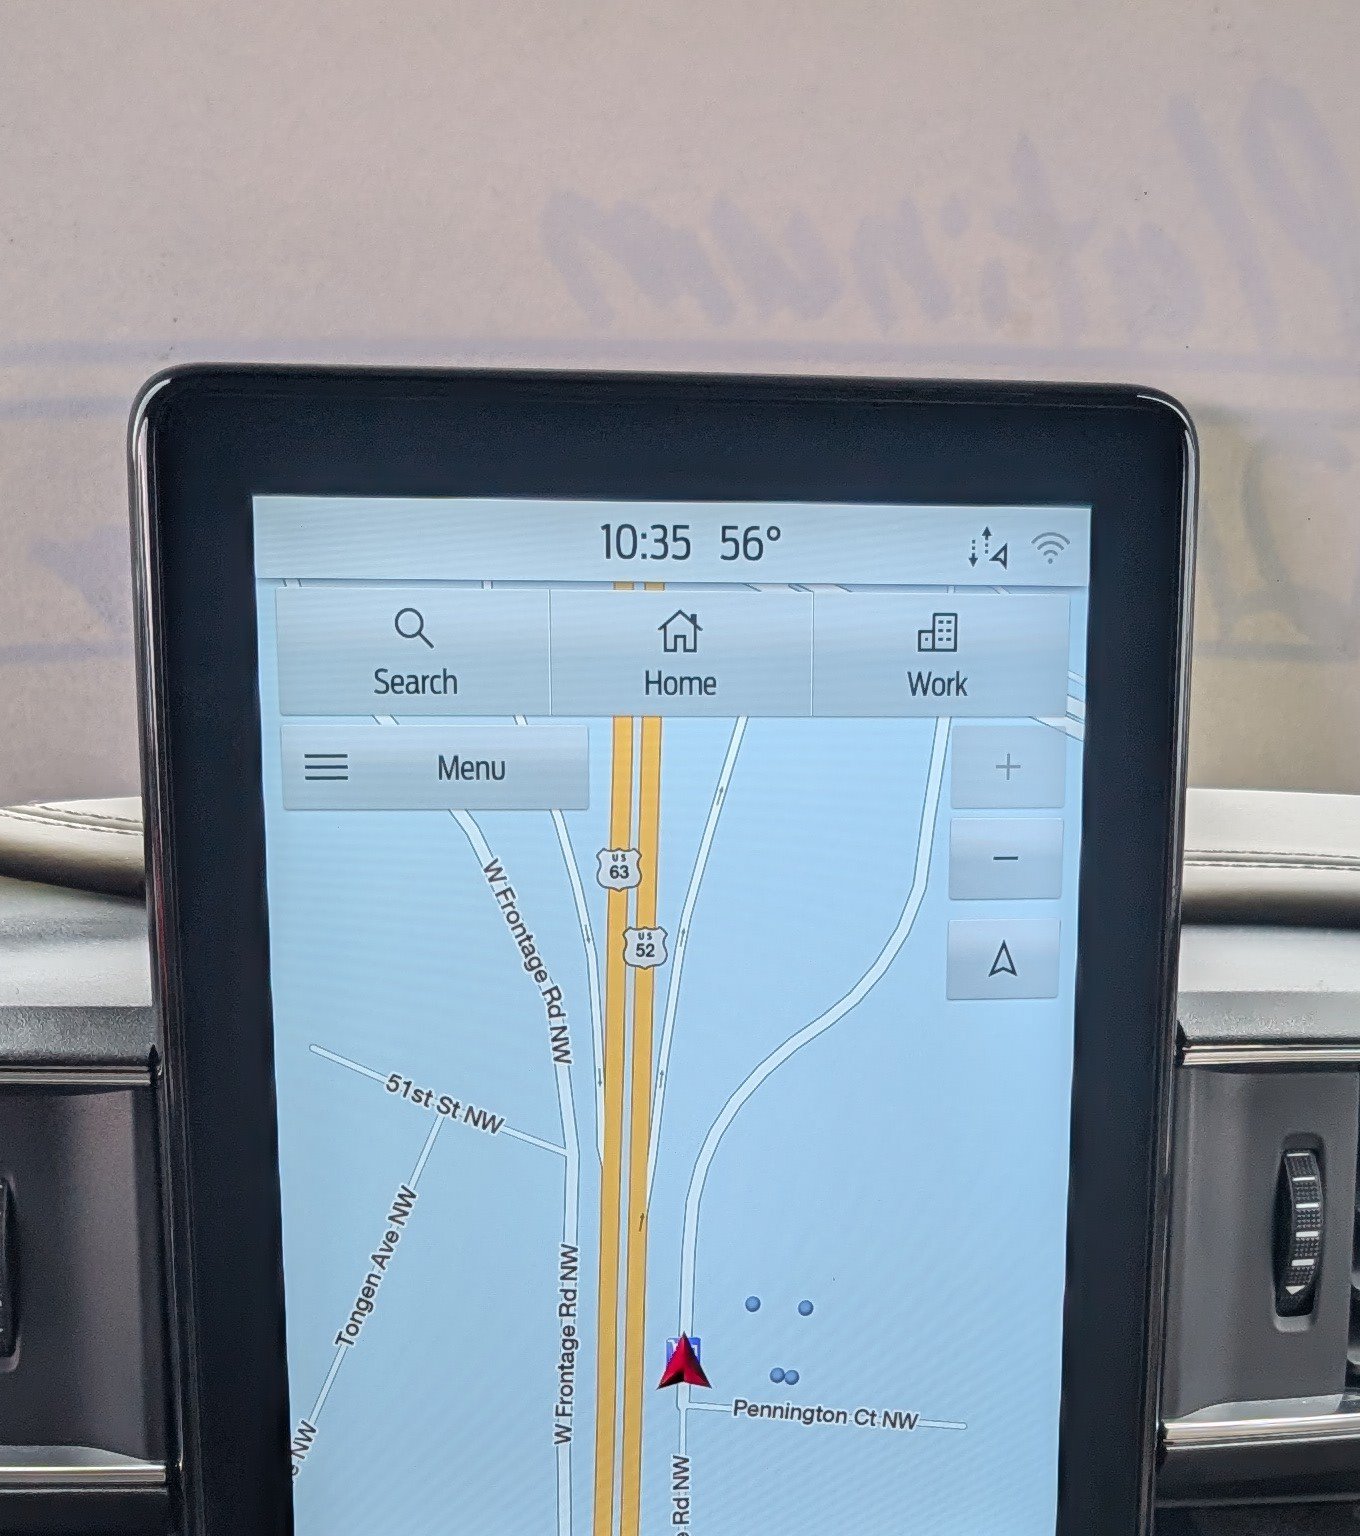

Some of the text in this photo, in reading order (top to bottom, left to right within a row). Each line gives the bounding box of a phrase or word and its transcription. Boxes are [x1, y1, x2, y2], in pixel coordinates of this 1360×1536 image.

[600, 523, 783, 563] 10:35 56°
[373, 667, 459, 697] Search
[643, 669, 718, 698] Home
[906, 670, 969, 698] Work
[437, 755, 507, 782] Menu
[608, 865, 630, 880] 63
[611, 853, 627, 862] US
[635, 943, 656, 958] 52
[637, 932, 653, 941] US
[483, 858, 573, 1065] W Frontage Rd NW
[385, 1073, 506, 1135] 51st St NW
[334, 1184, 418, 1347] Tongen Ave NW
[553, 1243, 580, 1445] W Frontage Rd NW
[733, 1399, 920, 1430] Pennington Ct NW
[290, 1419, 317, 1460] NW
[672, 1455, 690, 1490] NW
[672, 1497, 690, 1525] Rd
